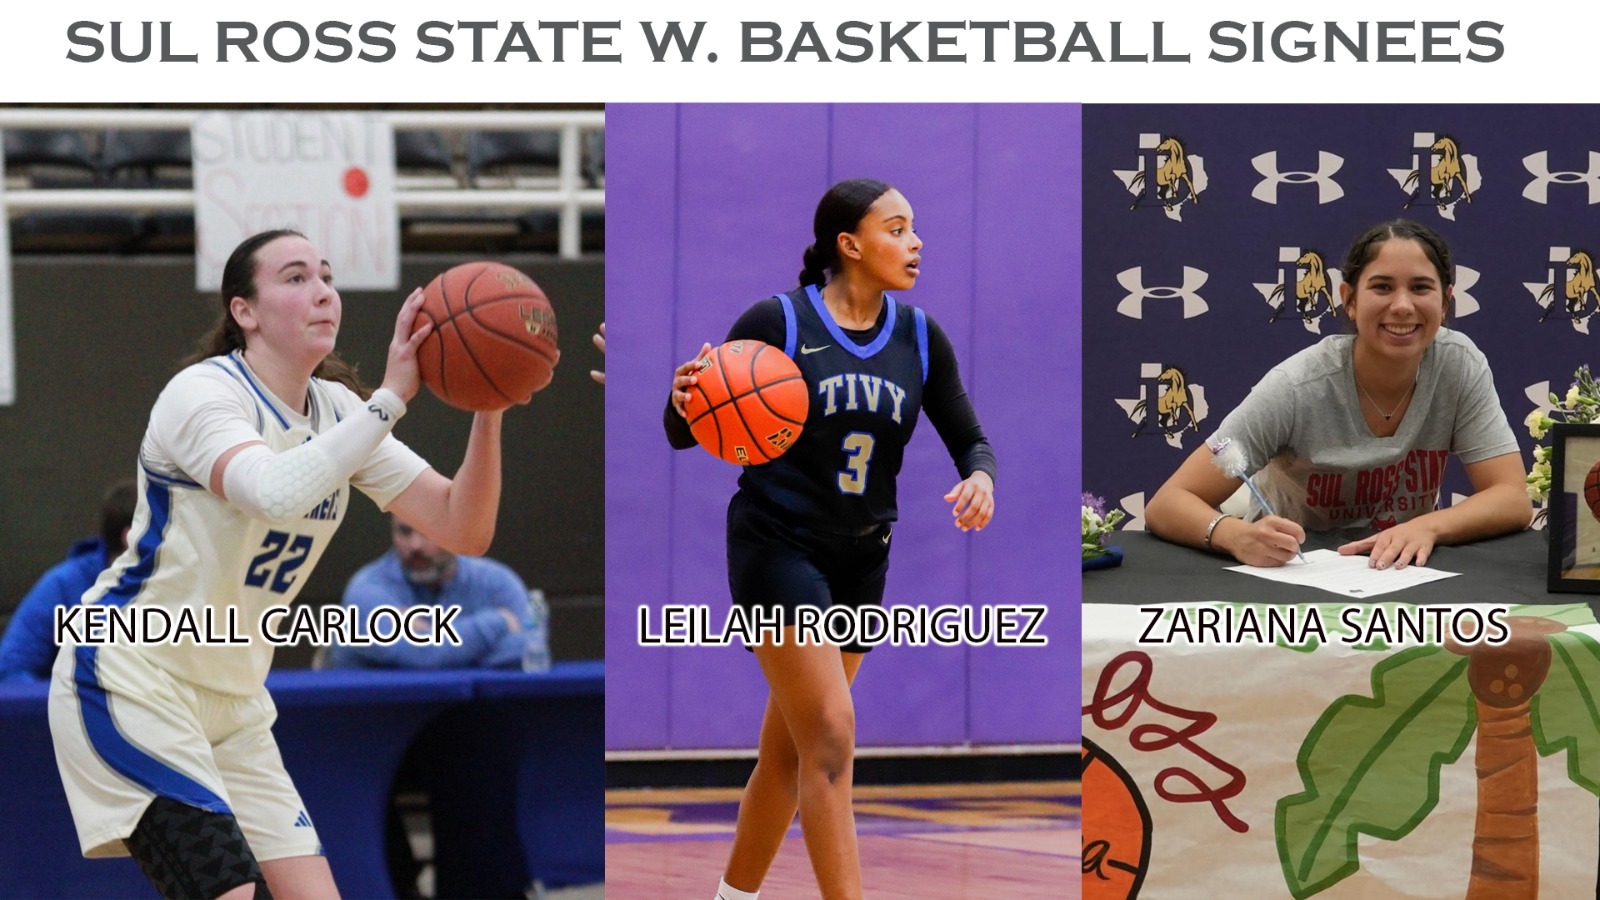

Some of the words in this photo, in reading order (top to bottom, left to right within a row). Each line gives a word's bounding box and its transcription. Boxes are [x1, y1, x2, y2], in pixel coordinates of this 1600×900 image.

[819, 373, 905, 424] TIVY
[837, 431, 876, 496] 3
[1306, 473, 1346, 508] SUL
[1329, 493, 1438, 520] UNIVRSITY
[244, 529, 314, 595] 22
